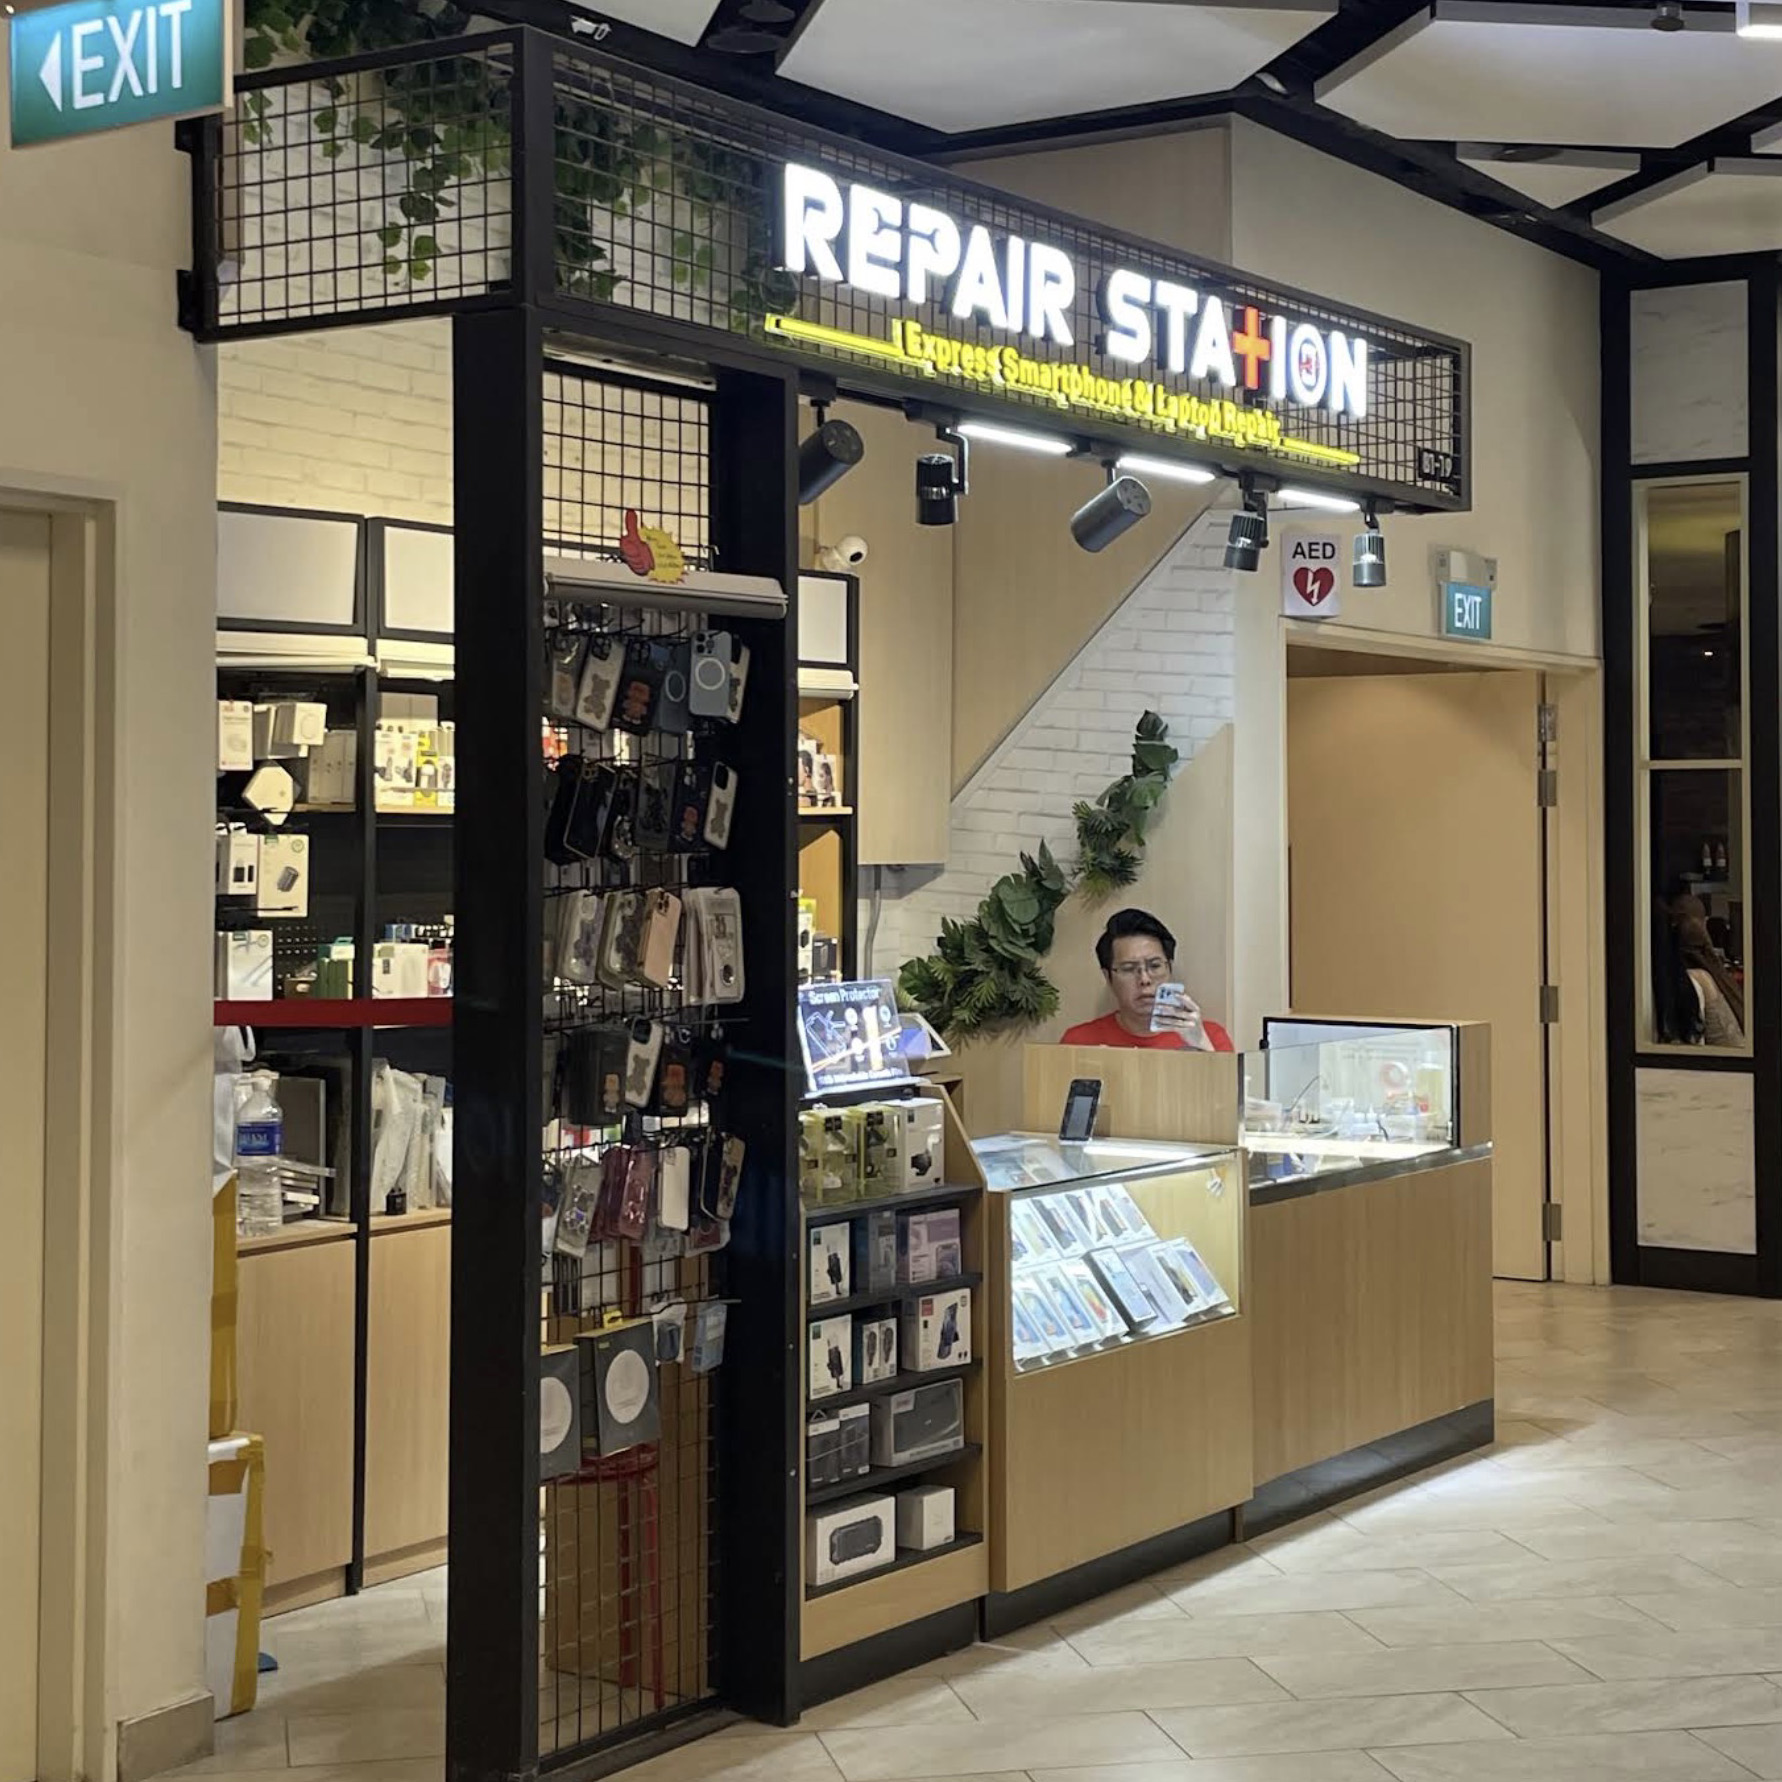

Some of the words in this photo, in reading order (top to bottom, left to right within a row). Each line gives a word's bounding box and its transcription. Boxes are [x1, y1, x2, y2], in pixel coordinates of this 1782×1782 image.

[72, 0, 192, 110] EXIT
[784, 162, 1076, 347] REPAIR
[904, 319, 1001, 380] Express
[1002, 346, 1134, 414] Smartphone
[1155, 384, 1222, 436] Laptop
[1223, 400, 1281, 446] Repair
[1292, 542, 1336, 559] AED
[1454, 593, 1482, 630] EXIT
